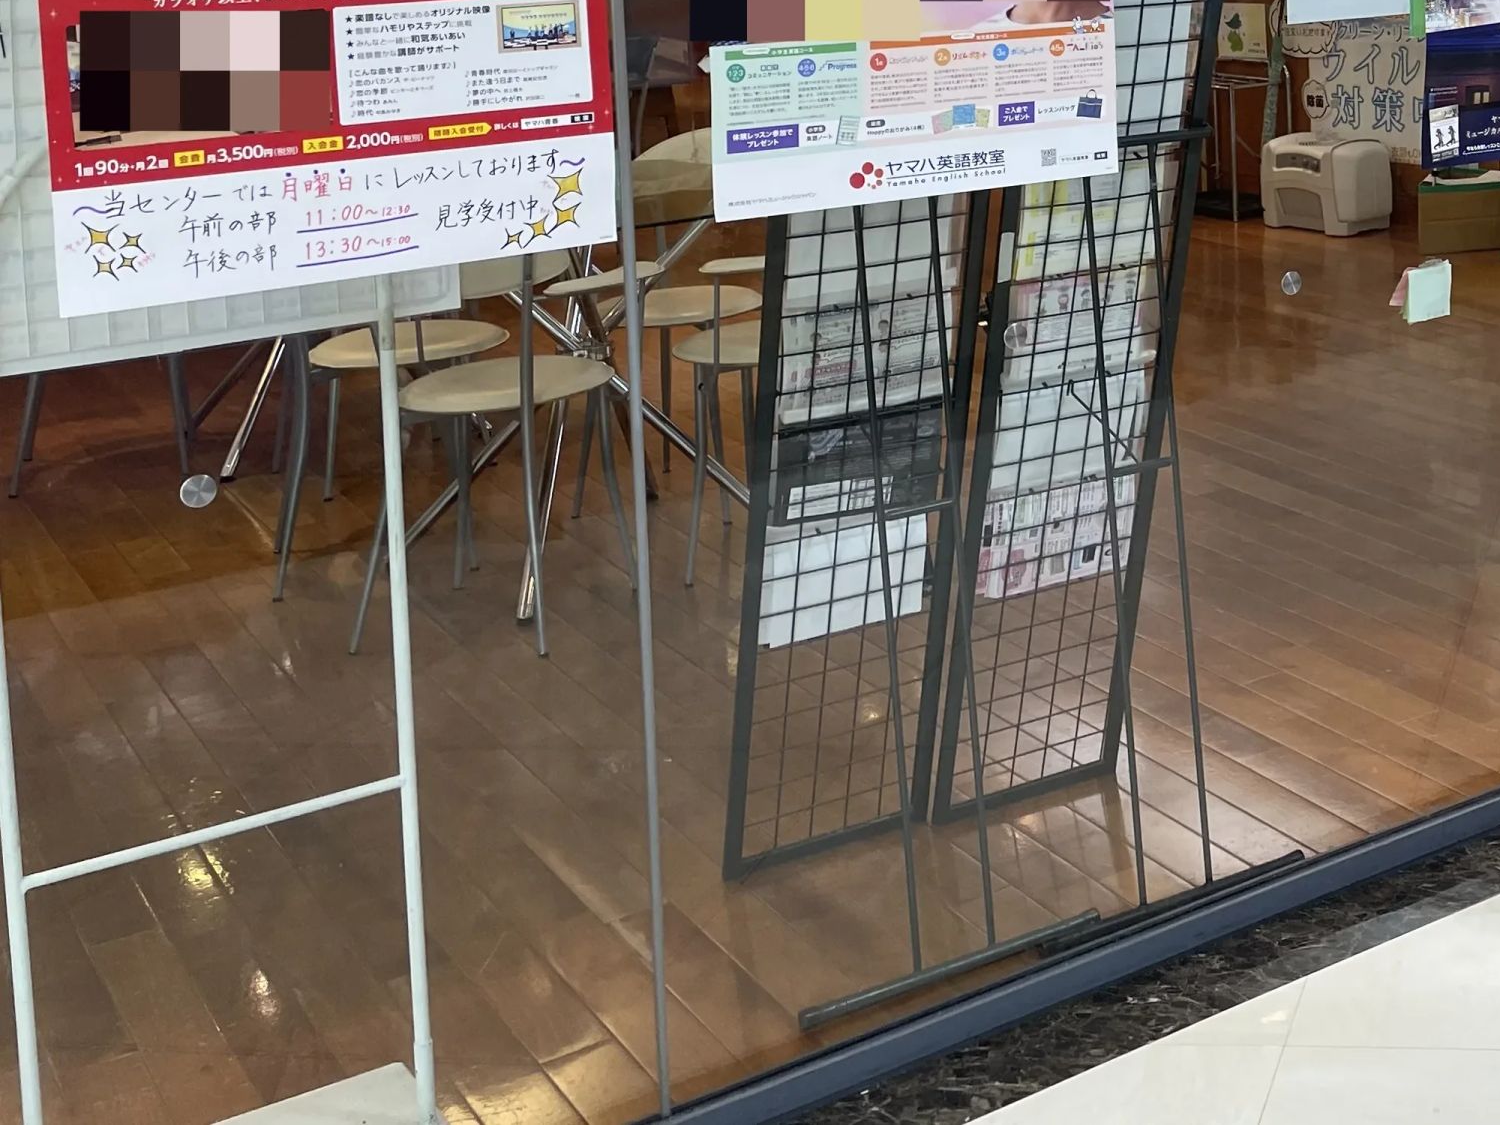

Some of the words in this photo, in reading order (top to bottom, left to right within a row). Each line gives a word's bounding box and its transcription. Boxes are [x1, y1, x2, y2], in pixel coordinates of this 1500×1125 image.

[1003, 113, 1030, 122] プレゼント
[178, 153, 201, 164] 会費
[307, 139, 338, 151] 入会金
[747, 139, 779, 148] プレゼント
[886, 150, 1005, 176] ヤマハ英語教室
[887, 177, 926, 187] Yamaha
[932, 171, 969, 184] English
[974, 167, 1006, 178] School
[179, 211, 276, 243] 午前の部
[436, 195, 539, 231] 見学受付中
[183, 244, 277, 277] 午後の部
